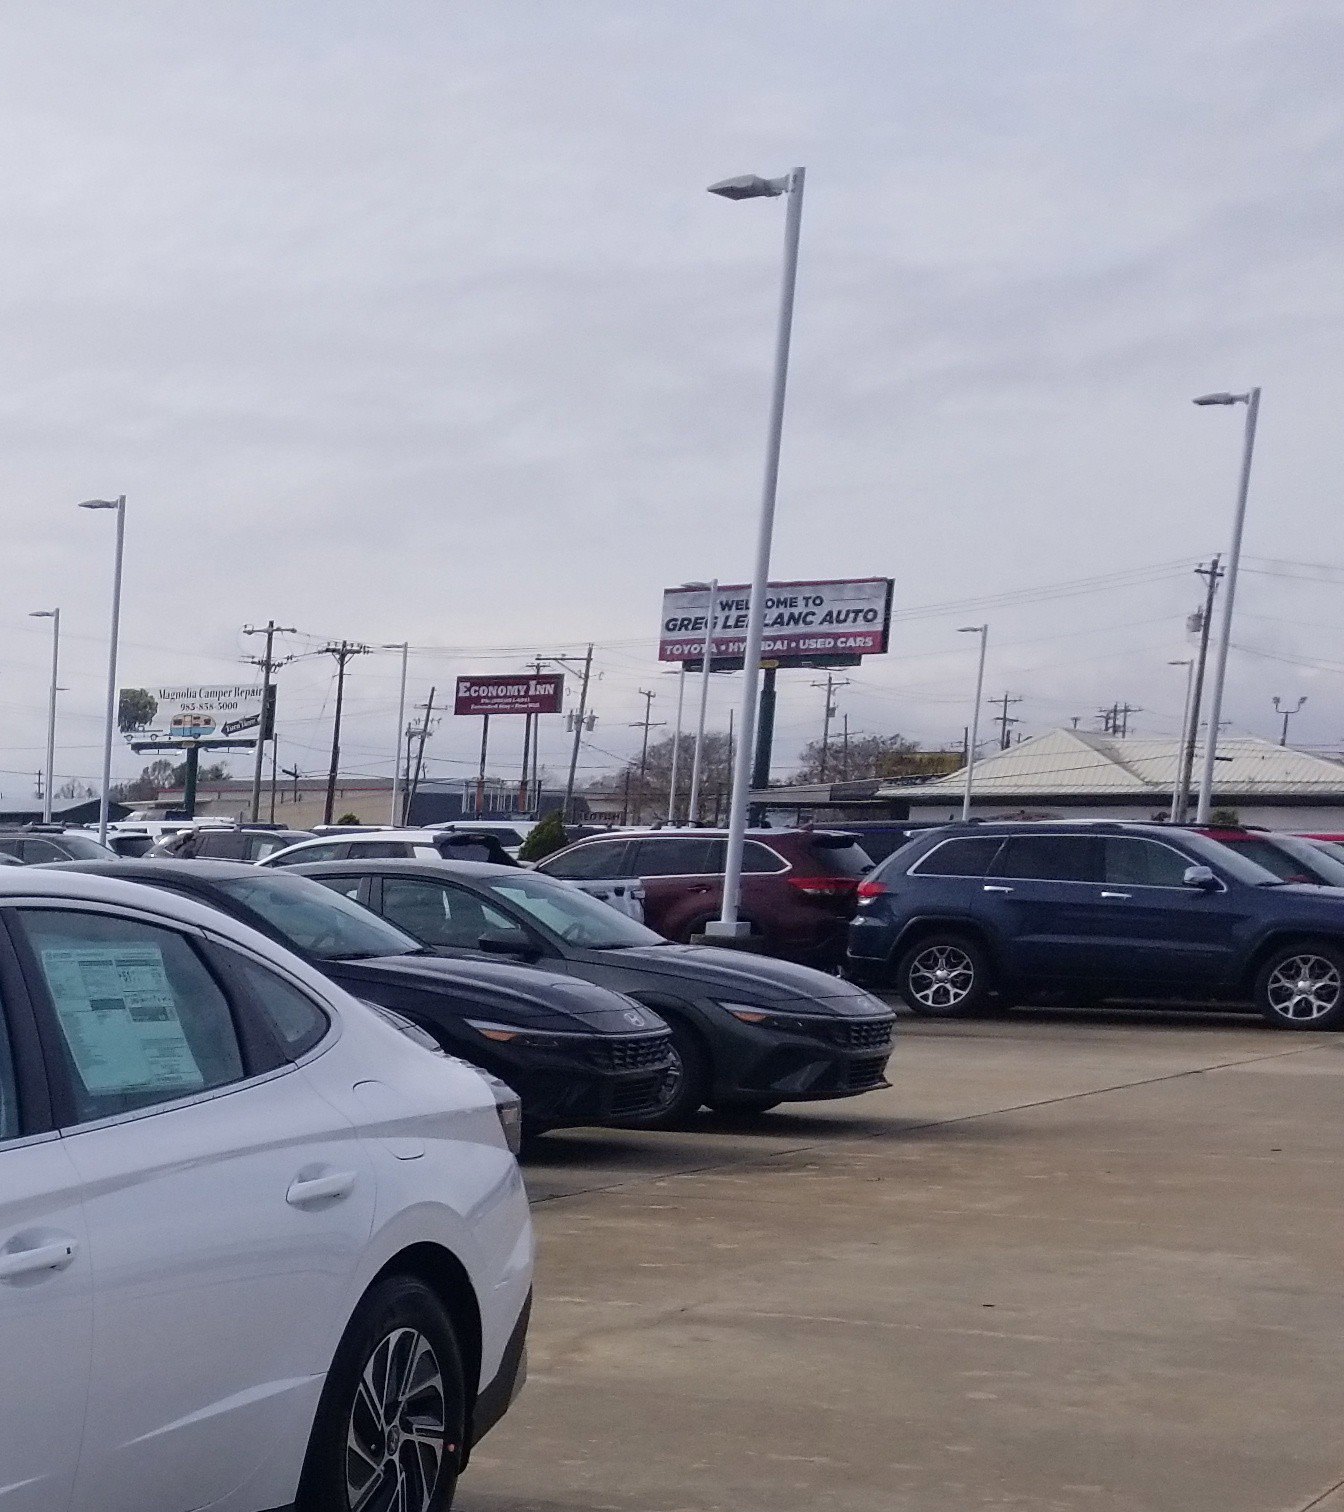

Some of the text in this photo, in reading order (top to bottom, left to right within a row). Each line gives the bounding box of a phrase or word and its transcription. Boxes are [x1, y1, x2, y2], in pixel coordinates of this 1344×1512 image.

[719, 595, 825, 612] WELOME TO
[721, 610, 817, 630] LELANC
[818, 607, 878, 625] AUTO
[728, 640, 788, 653] HYDAI
[799, 638, 835, 649] USED
[837, 636, 874, 648] CARS
[159, 686, 263, 701] Magnolia Camper Repair
[458, 680, 555, 697] ECONOMY INN
